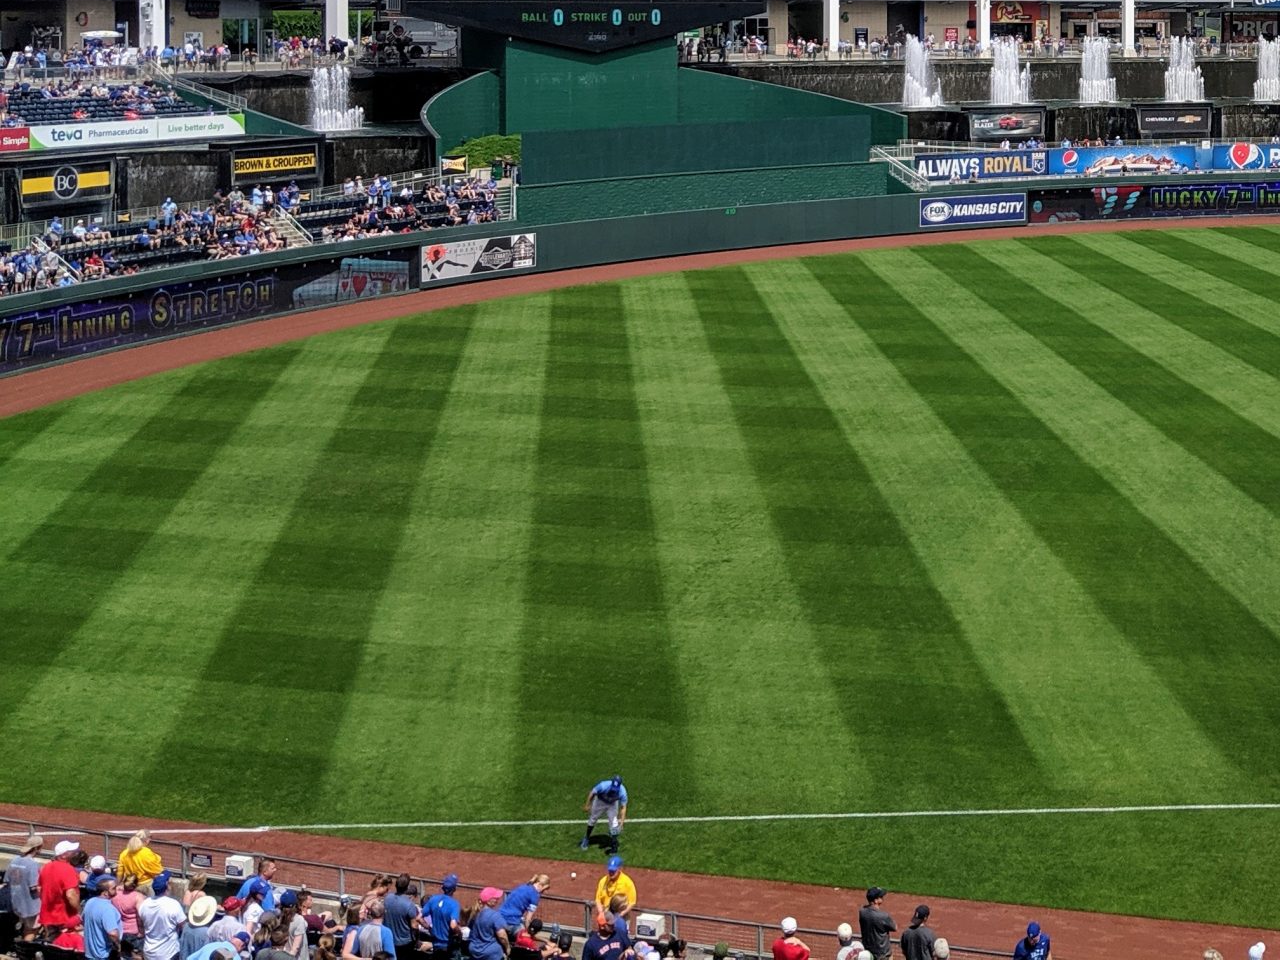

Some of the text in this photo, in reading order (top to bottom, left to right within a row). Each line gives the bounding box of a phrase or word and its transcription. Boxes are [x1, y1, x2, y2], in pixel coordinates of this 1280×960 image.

[522, 9, 661, 26] BALL 0 STRIKE 0 OUT 0
[51, 122, 225, 142] teva Pharmaceuticals Live better days
[3, 136, 28, 146] Simple
[234, 154, 313, 171] BROWN & CROUPPEN
[917, 156, 1032, 177] ALWAYS ROYAL
[57, 174, 76, 191] BC
[1154, 190, 1217, 208] LUCKY
[929, 206, 946, 214] FOX
[953, 203, 997, 217] KANSAS
[62, 311, 131, 342] INNING
[154, 285, 270, 323] STRETCH
